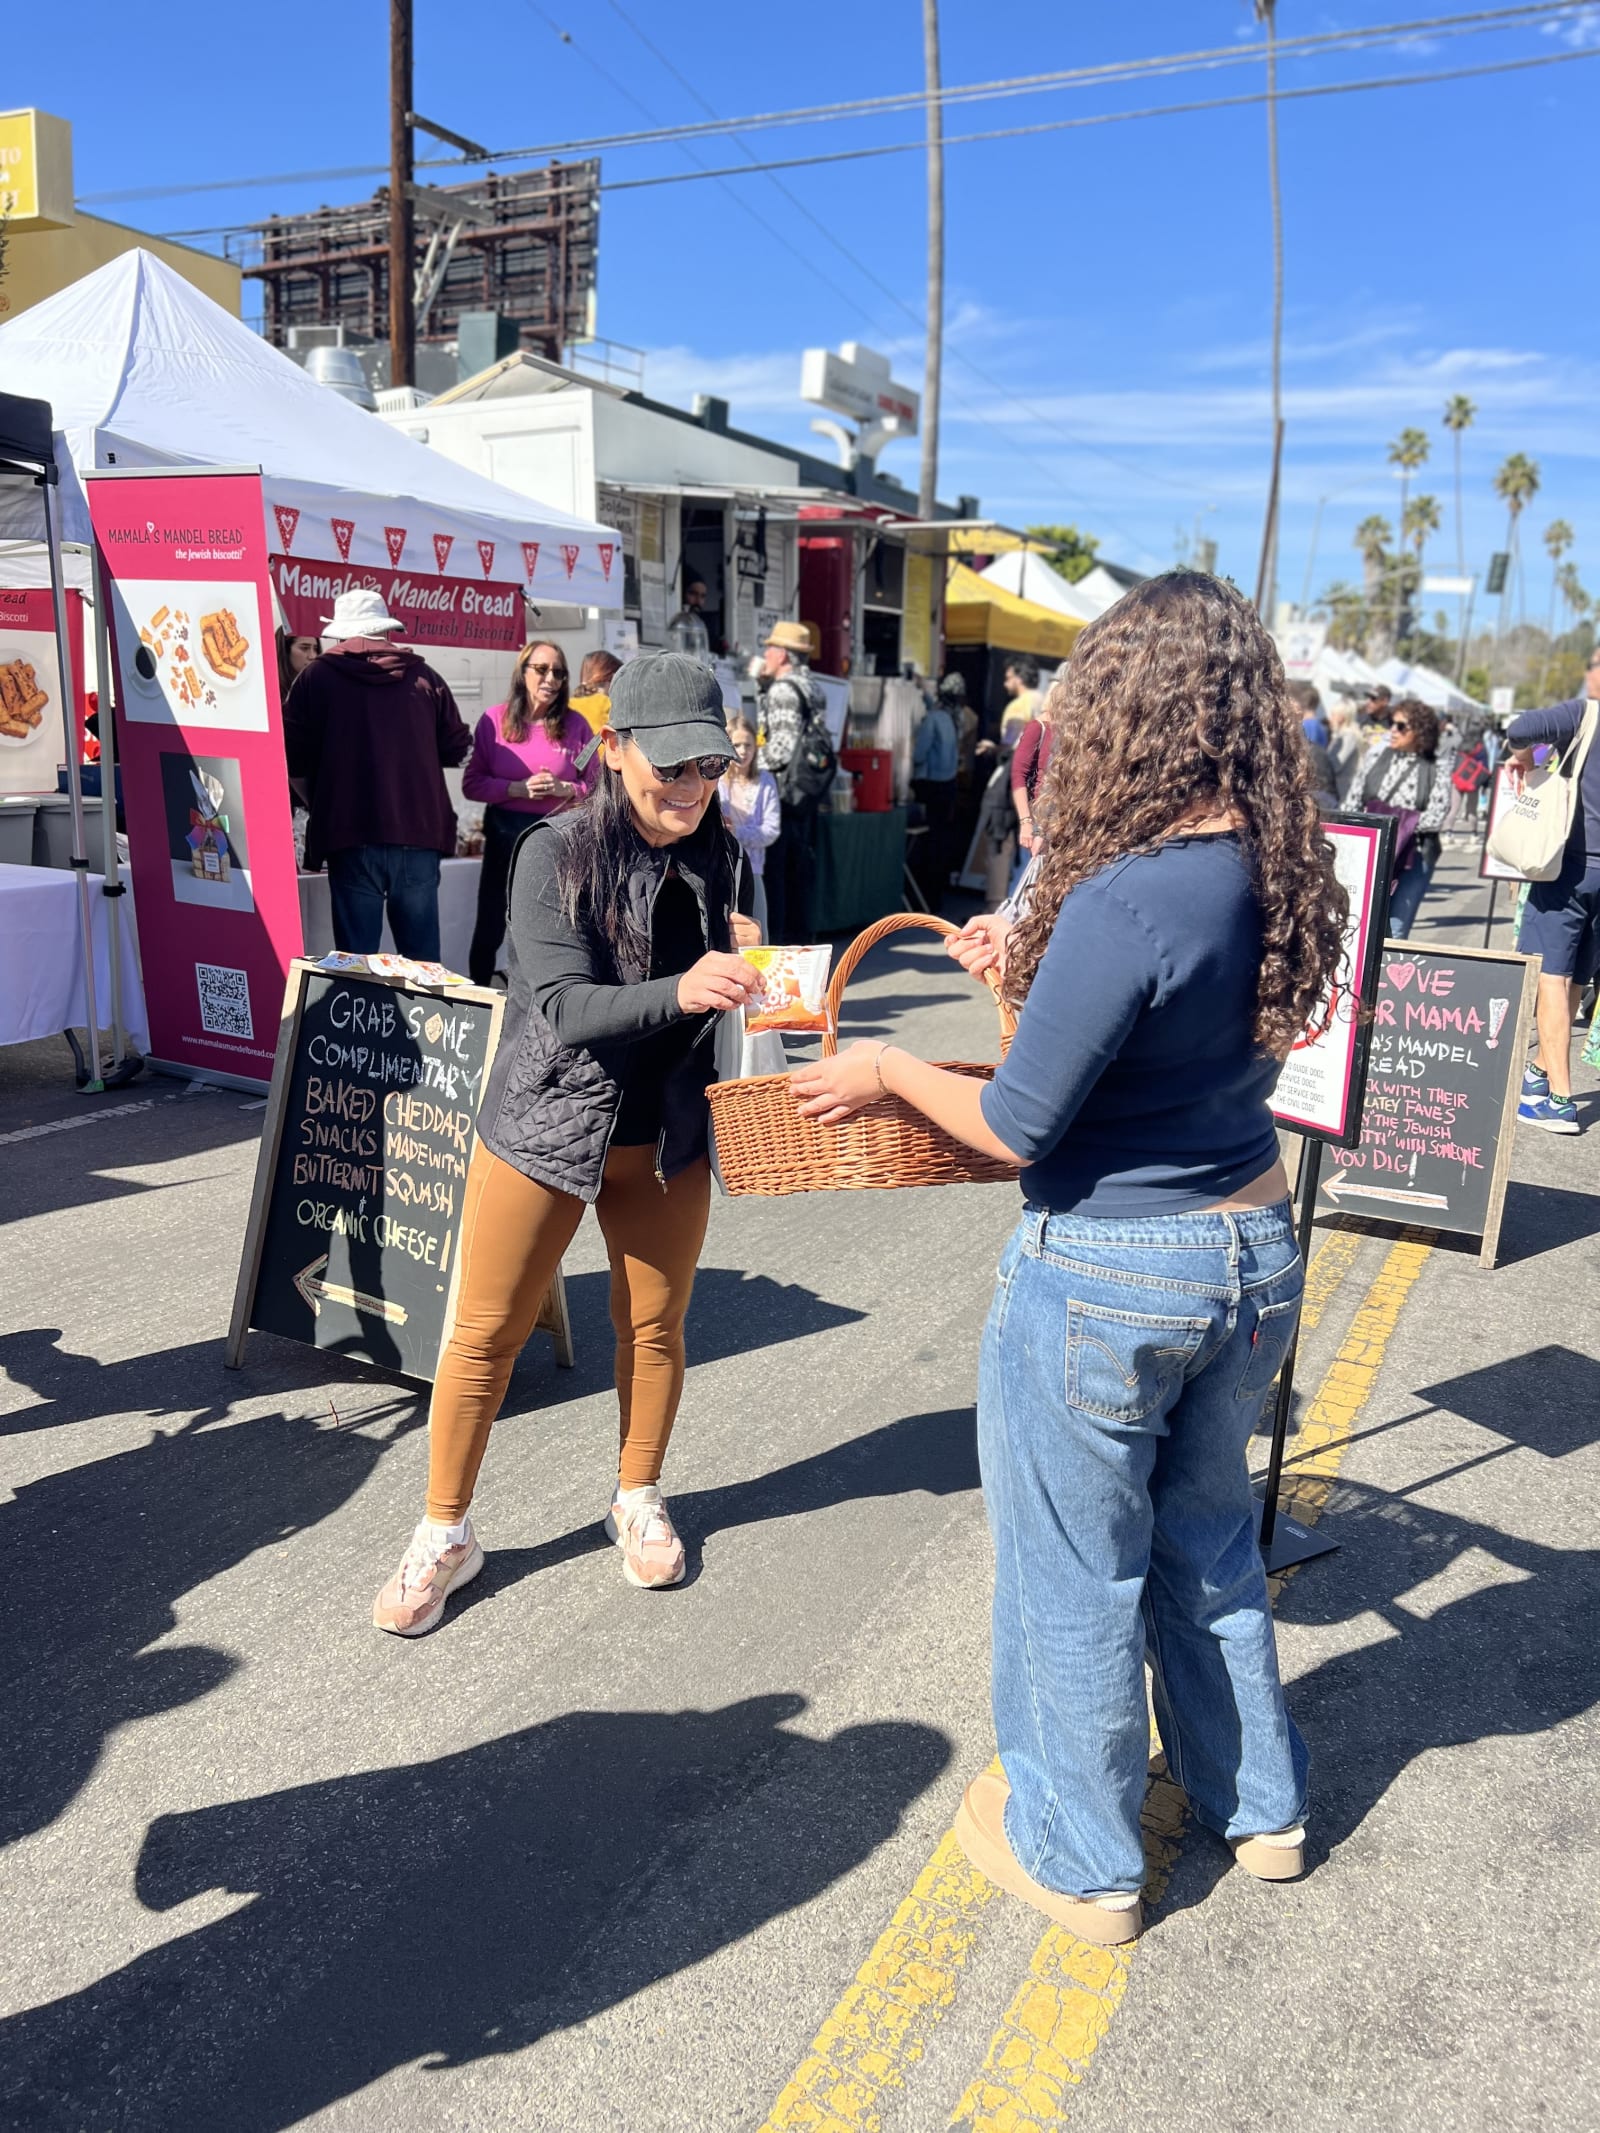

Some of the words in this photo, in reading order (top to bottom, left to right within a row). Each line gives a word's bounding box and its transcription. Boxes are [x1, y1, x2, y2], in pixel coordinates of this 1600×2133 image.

[164, 529, 205, 544] MANDEL
[208, 530, 243, 545] BREAD
[175, 549, 187, 559] the
[188, 549, 211, 561] Jewish
[388, 578, 455, 612] Mandel
[461, 587, 514, 617] Bread
[411, 615, 458, 638] Jewish
[464, 619, 515, 642] Biscotti
[329, 991, 396, 1038] GRAB
[1398, 1036, 1479, 1067] MANDEL
[309, 1035, 482, 1106] COMPLIMENTARY
[1383, 1081, 1421, 1100] WITH
[1427, 1087, 1470, 1109] THEIR
[306, 1075, 376, 1124] BAKED
[383, 1091, 471, 1153] CHEDDAR
[1405, 1100, 1456, 1124] FAVES
[300, 1118, 377, 1156] SNACKS
[1403, 1119, 1452, 1140] JEWISH
[1330, 1145, 1367, 1168] YOU
[1395, 1137, 1426, 1155] WITH
[1428, 1140, 1485, 1169] SOMEONE
[292, 1153, 384, 1195] BUTTERNUT
[385, 1168, 453, 1219] SQUASH
[297, 1200, 368, 1243] ORGANIC
